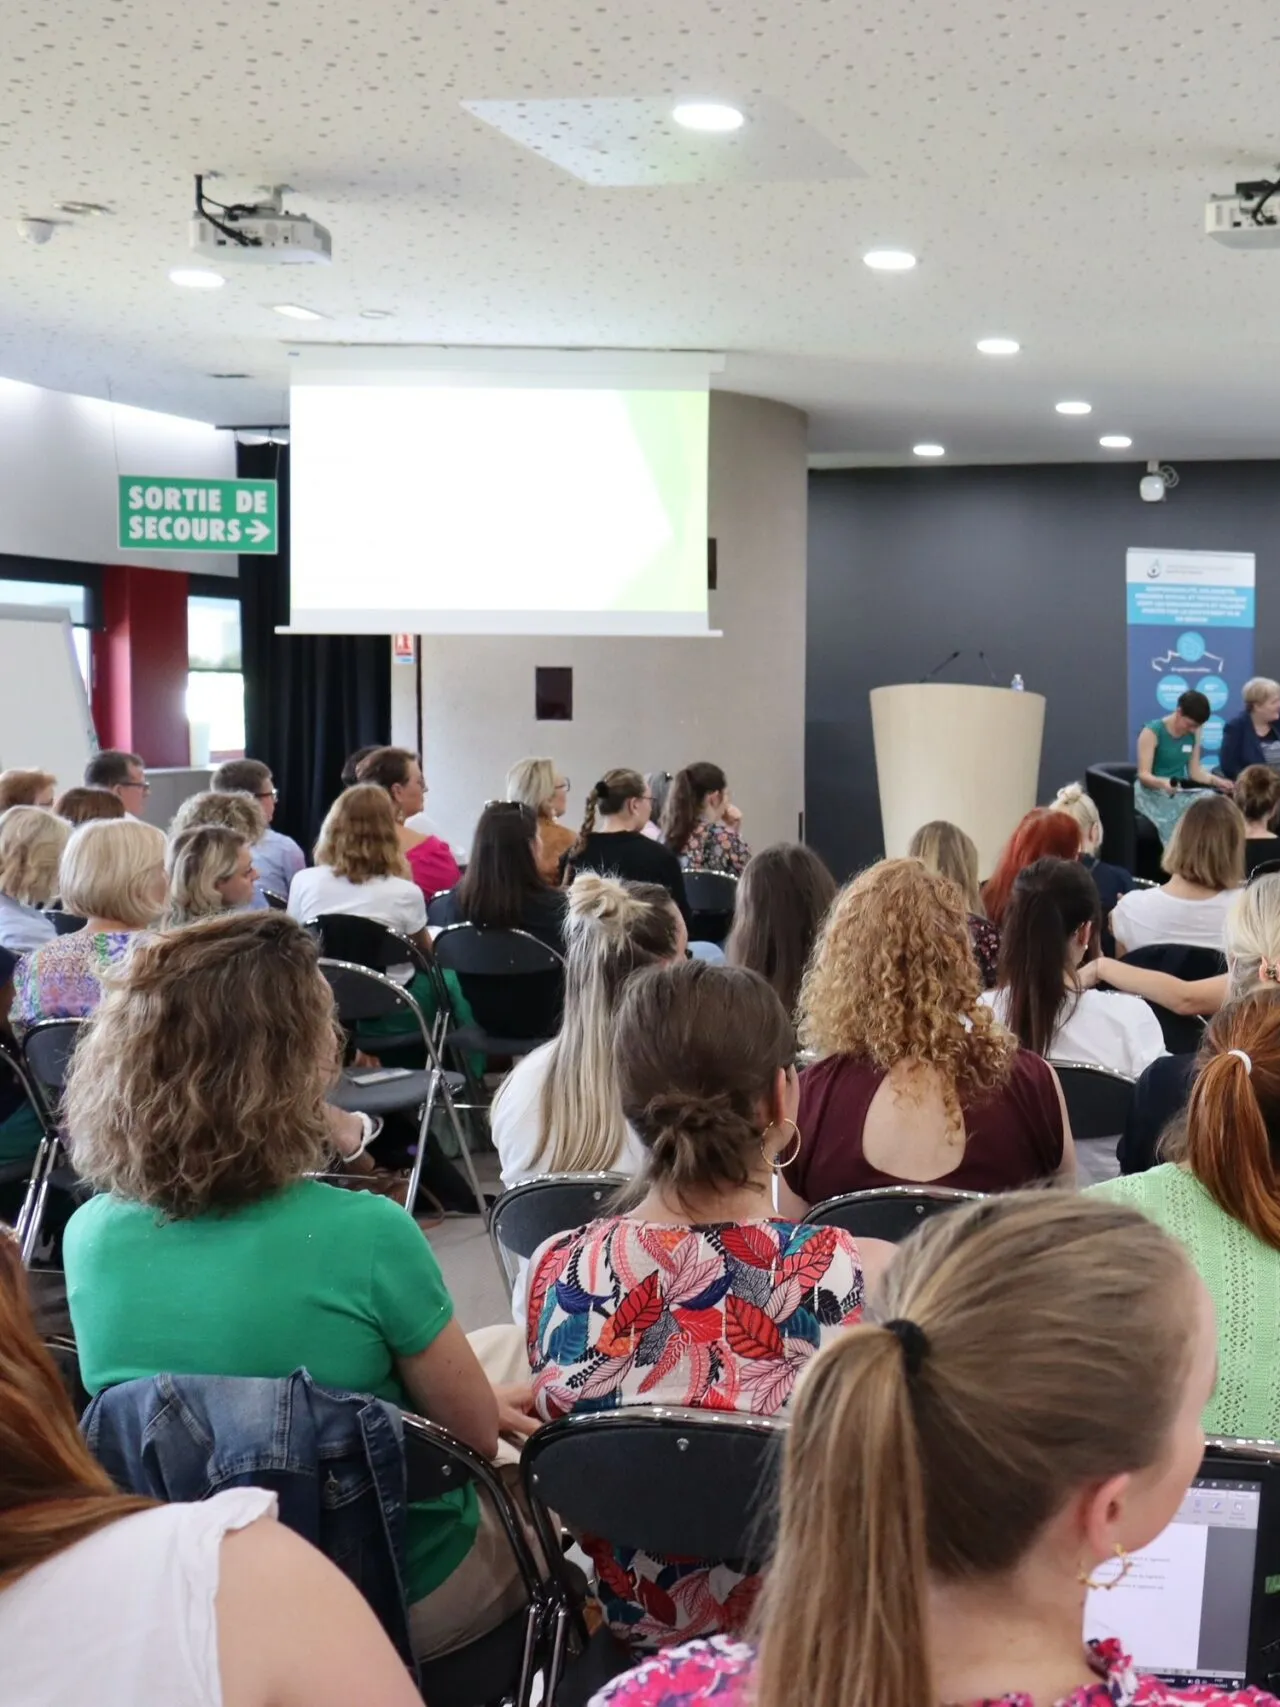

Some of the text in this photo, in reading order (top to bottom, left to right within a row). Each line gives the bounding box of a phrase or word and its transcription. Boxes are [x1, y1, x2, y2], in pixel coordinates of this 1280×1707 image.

[129, 485, 267, 514] SORTIE DE
[129, 515, 241, 542] SECOURS
